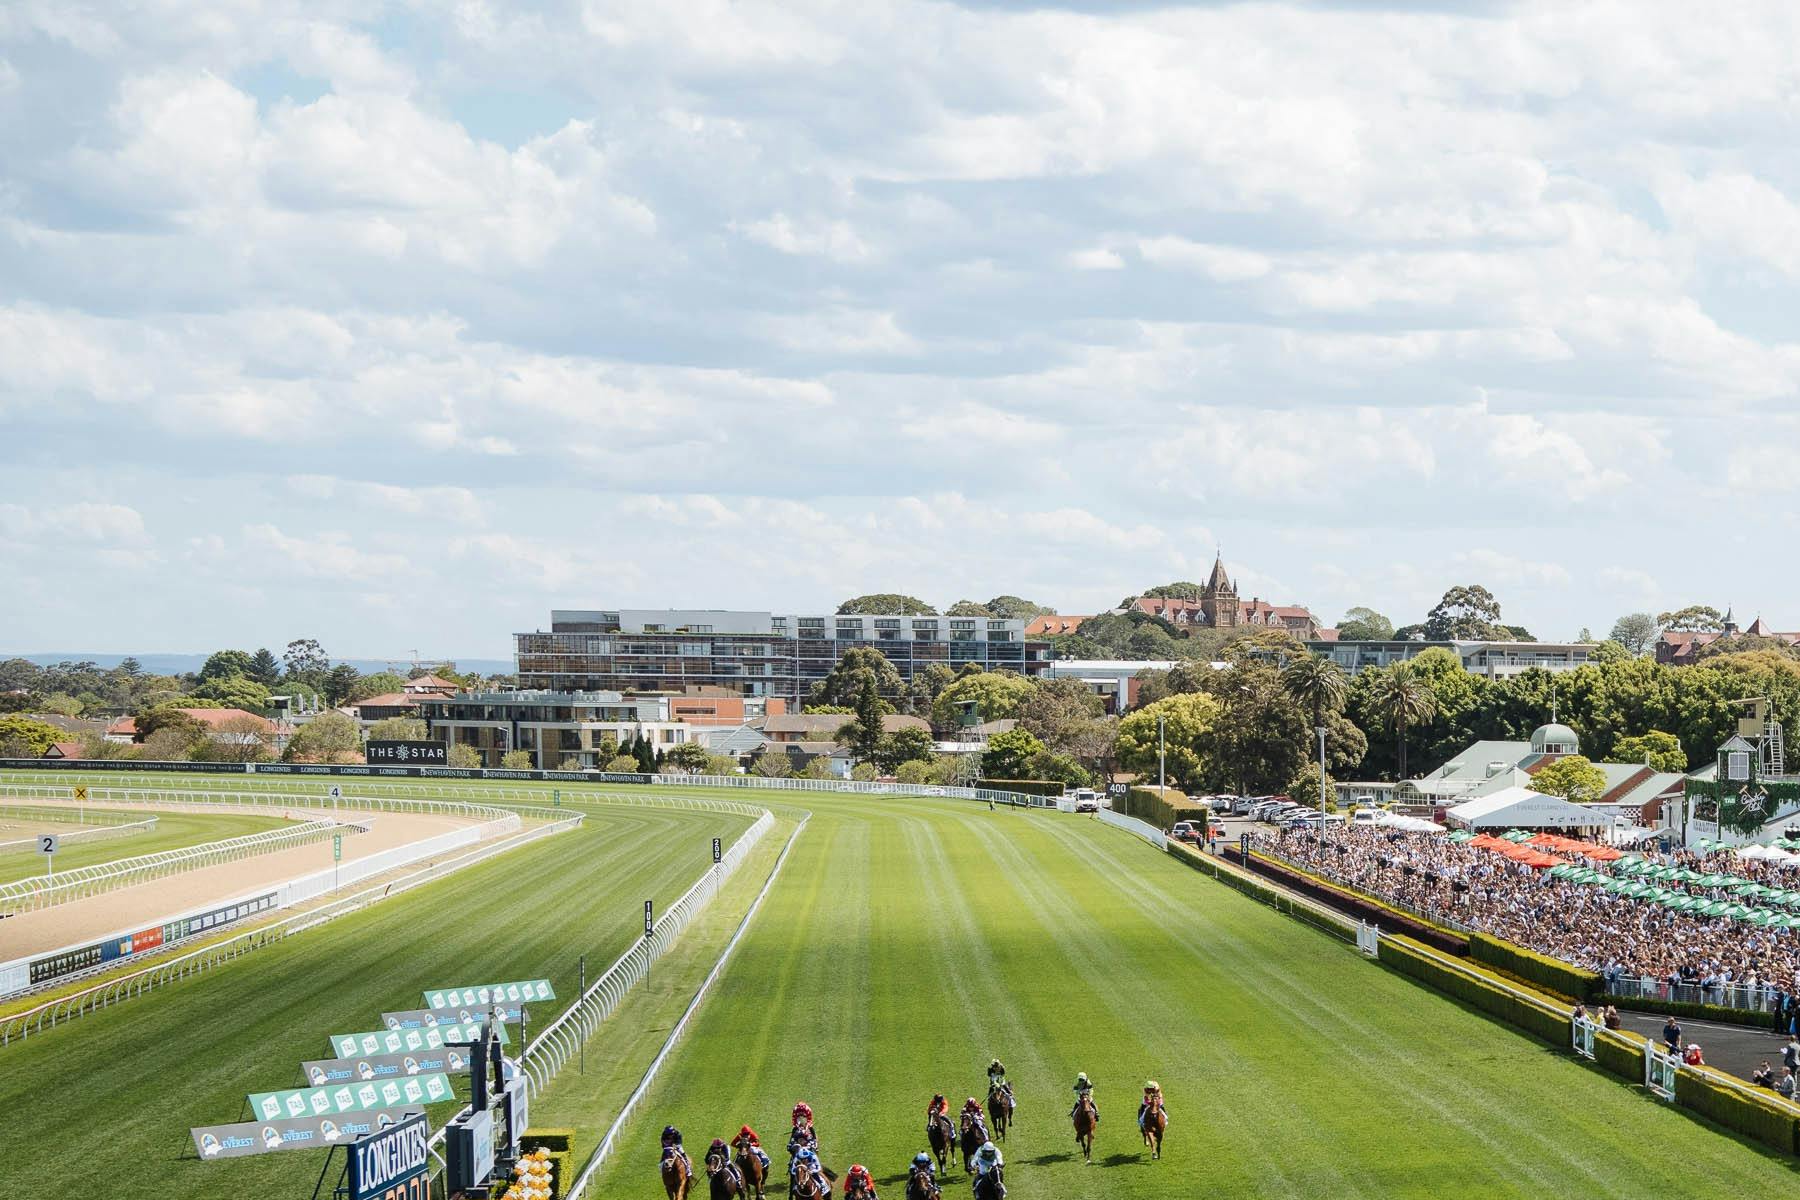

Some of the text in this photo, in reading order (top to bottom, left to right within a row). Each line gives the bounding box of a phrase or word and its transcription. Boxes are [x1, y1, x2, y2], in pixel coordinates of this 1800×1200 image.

[370, 747, 444, 758] THE STAR
[331, 788, 339, 797] 4
[1109, 784, 1126, 793] 400
[43, 838, 53, 852] 2
[341, 1124, 370, 1135] EVEREST
[283, 1131, 313, 1142] EVEREST
[222, 1137, 254, 1148] EVEREST
[358, 1120, 427, 1194] LONGINES
